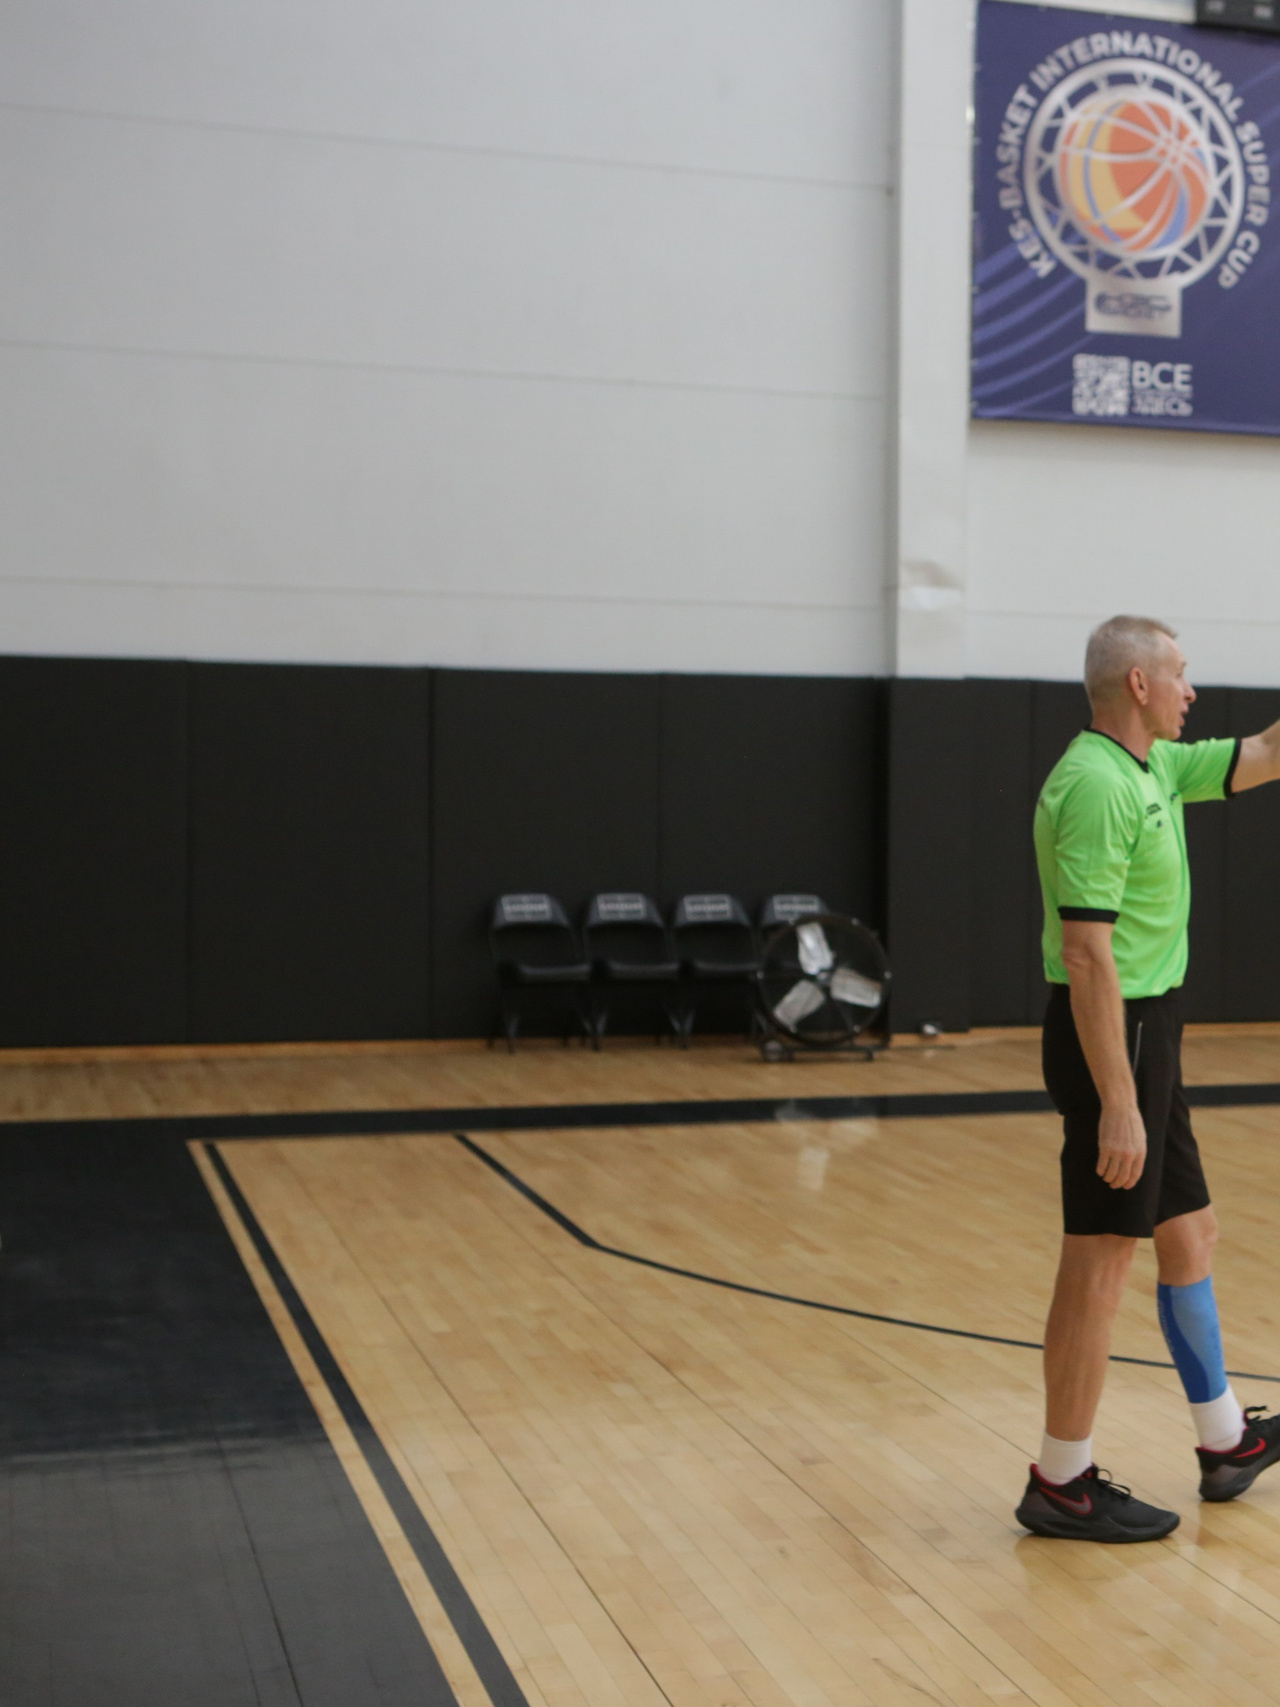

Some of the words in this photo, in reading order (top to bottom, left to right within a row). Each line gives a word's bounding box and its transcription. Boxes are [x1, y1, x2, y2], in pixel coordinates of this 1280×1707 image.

[1030, 31, 1245, 122] INTERNATIONAL
[1236, 121, 1270, 226] SUPER
[1218, 232, 1260, 289] CUP
[1132, 360, 1194, 392] ВСЕ
